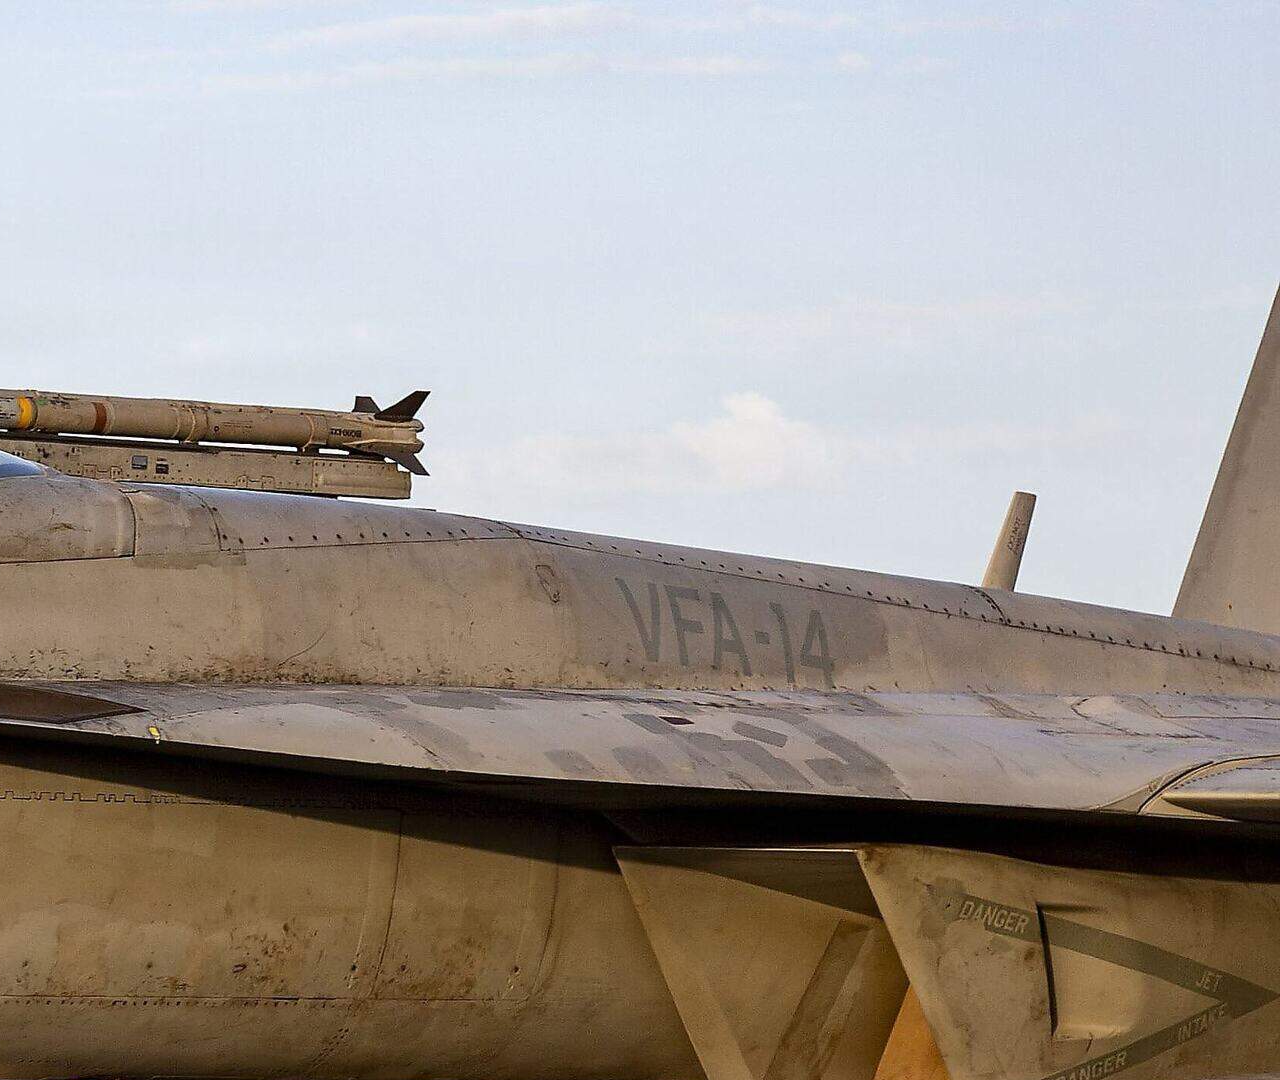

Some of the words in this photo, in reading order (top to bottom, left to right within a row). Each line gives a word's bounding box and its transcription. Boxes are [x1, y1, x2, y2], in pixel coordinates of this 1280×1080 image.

[615, 577, 836, 690] VFA-14
[959, 900, 1030, 934] DANGER
[1196, 970, 1224, 993] JET
